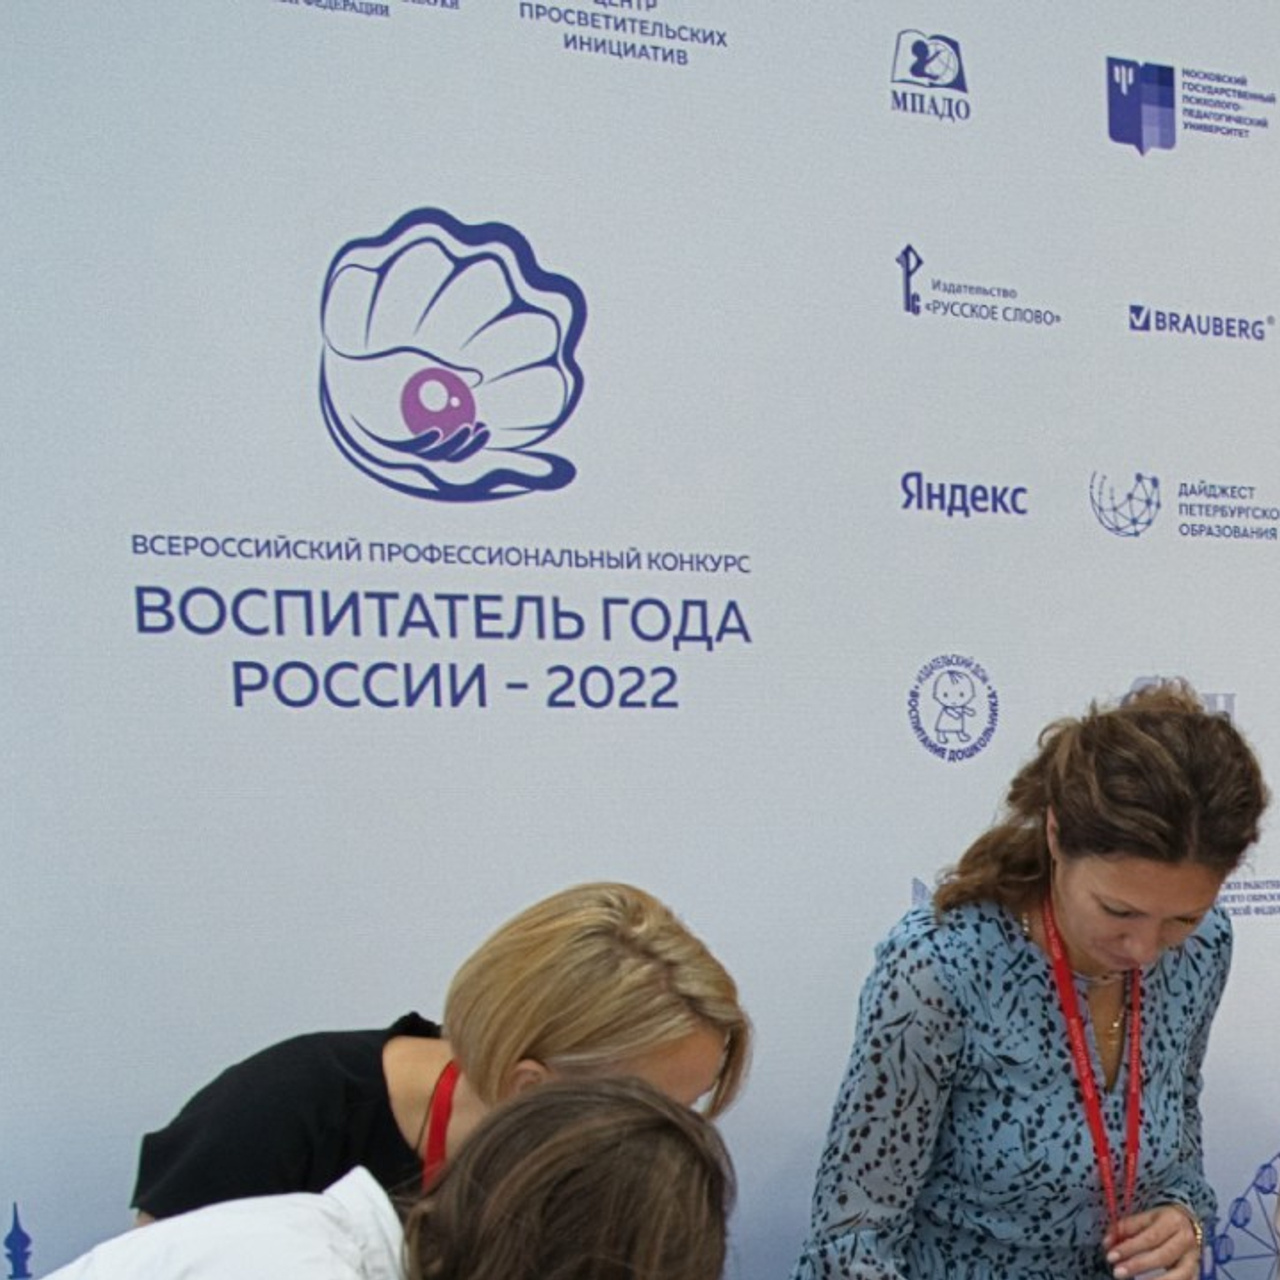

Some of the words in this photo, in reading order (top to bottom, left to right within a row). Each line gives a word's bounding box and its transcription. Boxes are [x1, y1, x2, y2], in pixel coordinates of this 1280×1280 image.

[519, 2, 728, 47] ПРОСВЕТИТЕЛЬСКИХ
[563, 33, 689, 66] ИНИЦИАТИВ
[1182, 68, 1247, 86] МОСКОВСКИЙ
[890, 90, 971, 122] МПАДО
[1182, 81, 1276, 104] ГОСУДАРСТВЕННЫЙ
[1183, 121, 1250, 138] УНИВЕРСИТЕТ
[931, 279, 1018, 299] Издательство
[925, 299, 999, 321] «РУССКОЕ
[1002, 306, 1062, 326] СЛОВО»
[900, 471, 1028, 517] Яндекс
[1178, 480, 1256, 499] ДАЙДЖЕСТ
[1179, 523, 1278, 541] ОБРАЗОВАНИЯ
[131, 534, 363, 562] ВСЕРОССИЙСКИЙ
[368, 542, 642, 570] ПРОФЕССИОНАЛЬНЫЙ
[647, 551, 752, 573] КОНКУРС
[134, 585, 586, 640] ВОСПИТАТЕЛЬ
[602, 597, 753, 652] ГОДА
[232, 660, 487, 708] РОССИИ
[546, 664, 679, 709] 2022
